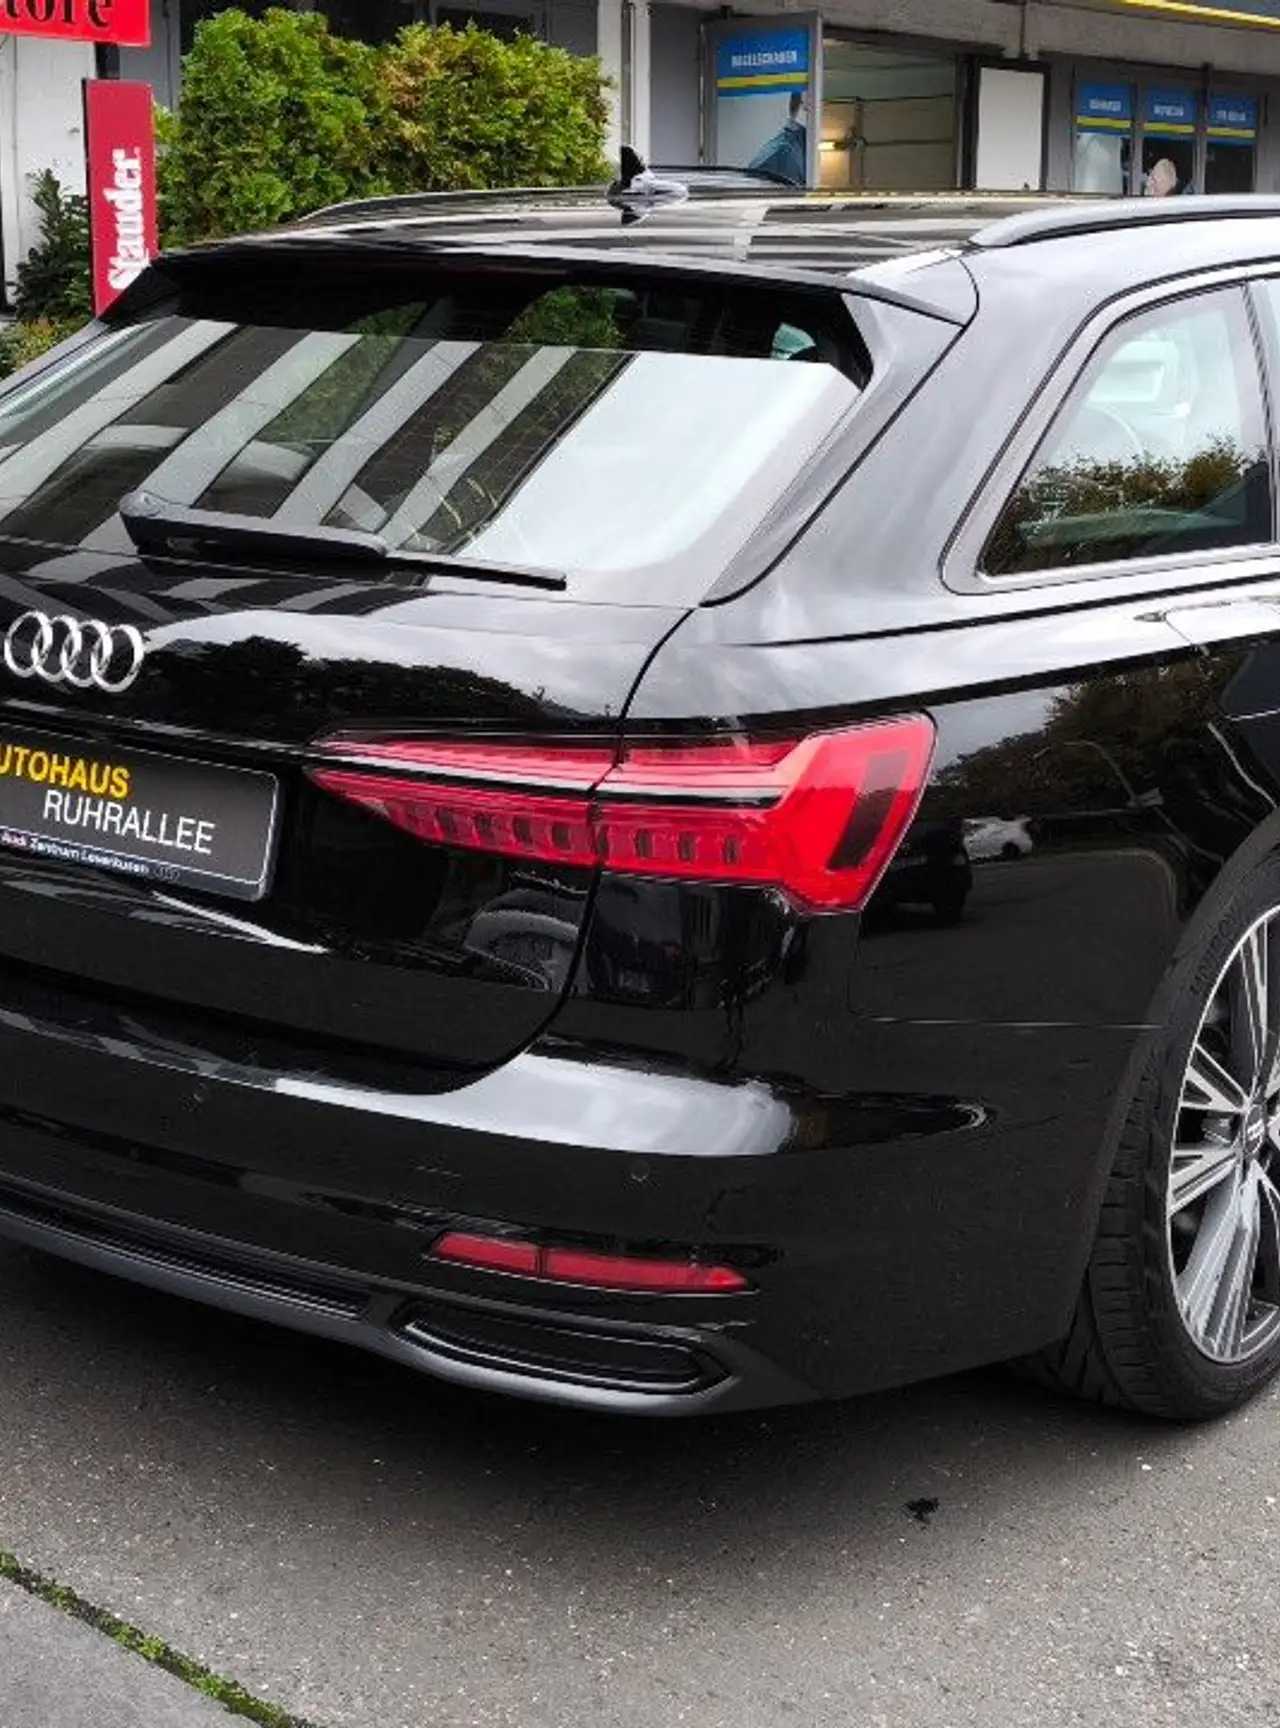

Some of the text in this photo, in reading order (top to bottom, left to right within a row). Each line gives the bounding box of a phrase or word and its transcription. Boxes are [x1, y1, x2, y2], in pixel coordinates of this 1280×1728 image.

[43, 789, 216, 854] RUHRALLEE
[29, 837, 80, 860] Zentrum
[81, 850, 150, 874] Leverkusen
